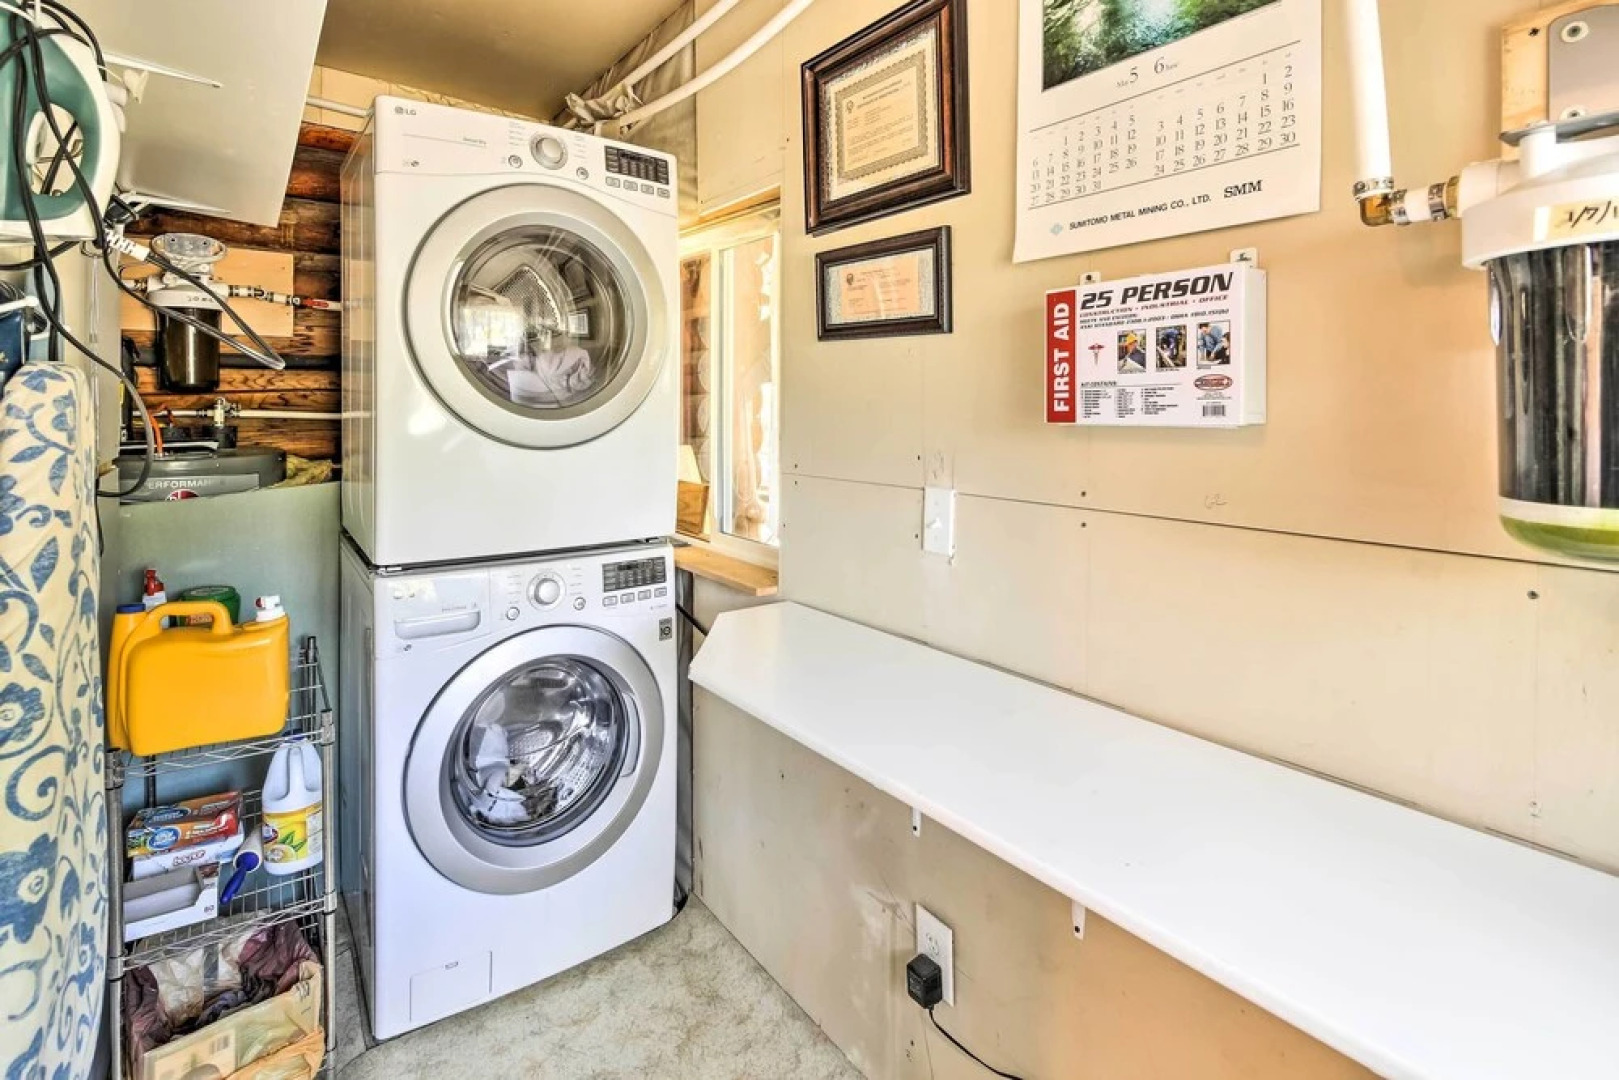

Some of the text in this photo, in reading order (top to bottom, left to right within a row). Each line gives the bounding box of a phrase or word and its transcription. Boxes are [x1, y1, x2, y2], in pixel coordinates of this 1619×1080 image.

[1129, 65, 1139, 84] 5
[1153, 56, 1165, 74] 6
[1285, 65, 1292, 78] 2
[1155, 98, 1294, 147] 10 11 12 13 14 15 16
[1158, 121, 1164, 131] 3
[1176, 114, 1183, 125] 4
[1197, 108, 1203, 120] 5
[1217, 102, 1224, 114] 6
[1239, 95, 1246, 107] 7
[1284, 82, 1292, 95] 9
[1154, 132, 1296, 176] 24 25 26 27 28 29 30
[1156, 114, 1296, 161] 17 18 19 20 21 22 23
[1069, 215, 1108, 231] SUMITOMO
[1110, 209, 1136, 222] METAL
[1138, 203, 1168, 216] MINING
[1192, 194, 1212, 205] LTD.
[1223, 179, 1264, 199] SMM
[1080, 271, 1235, 310] 25 PERSON
[1053, 302, 1071, 413] FIRST AID
